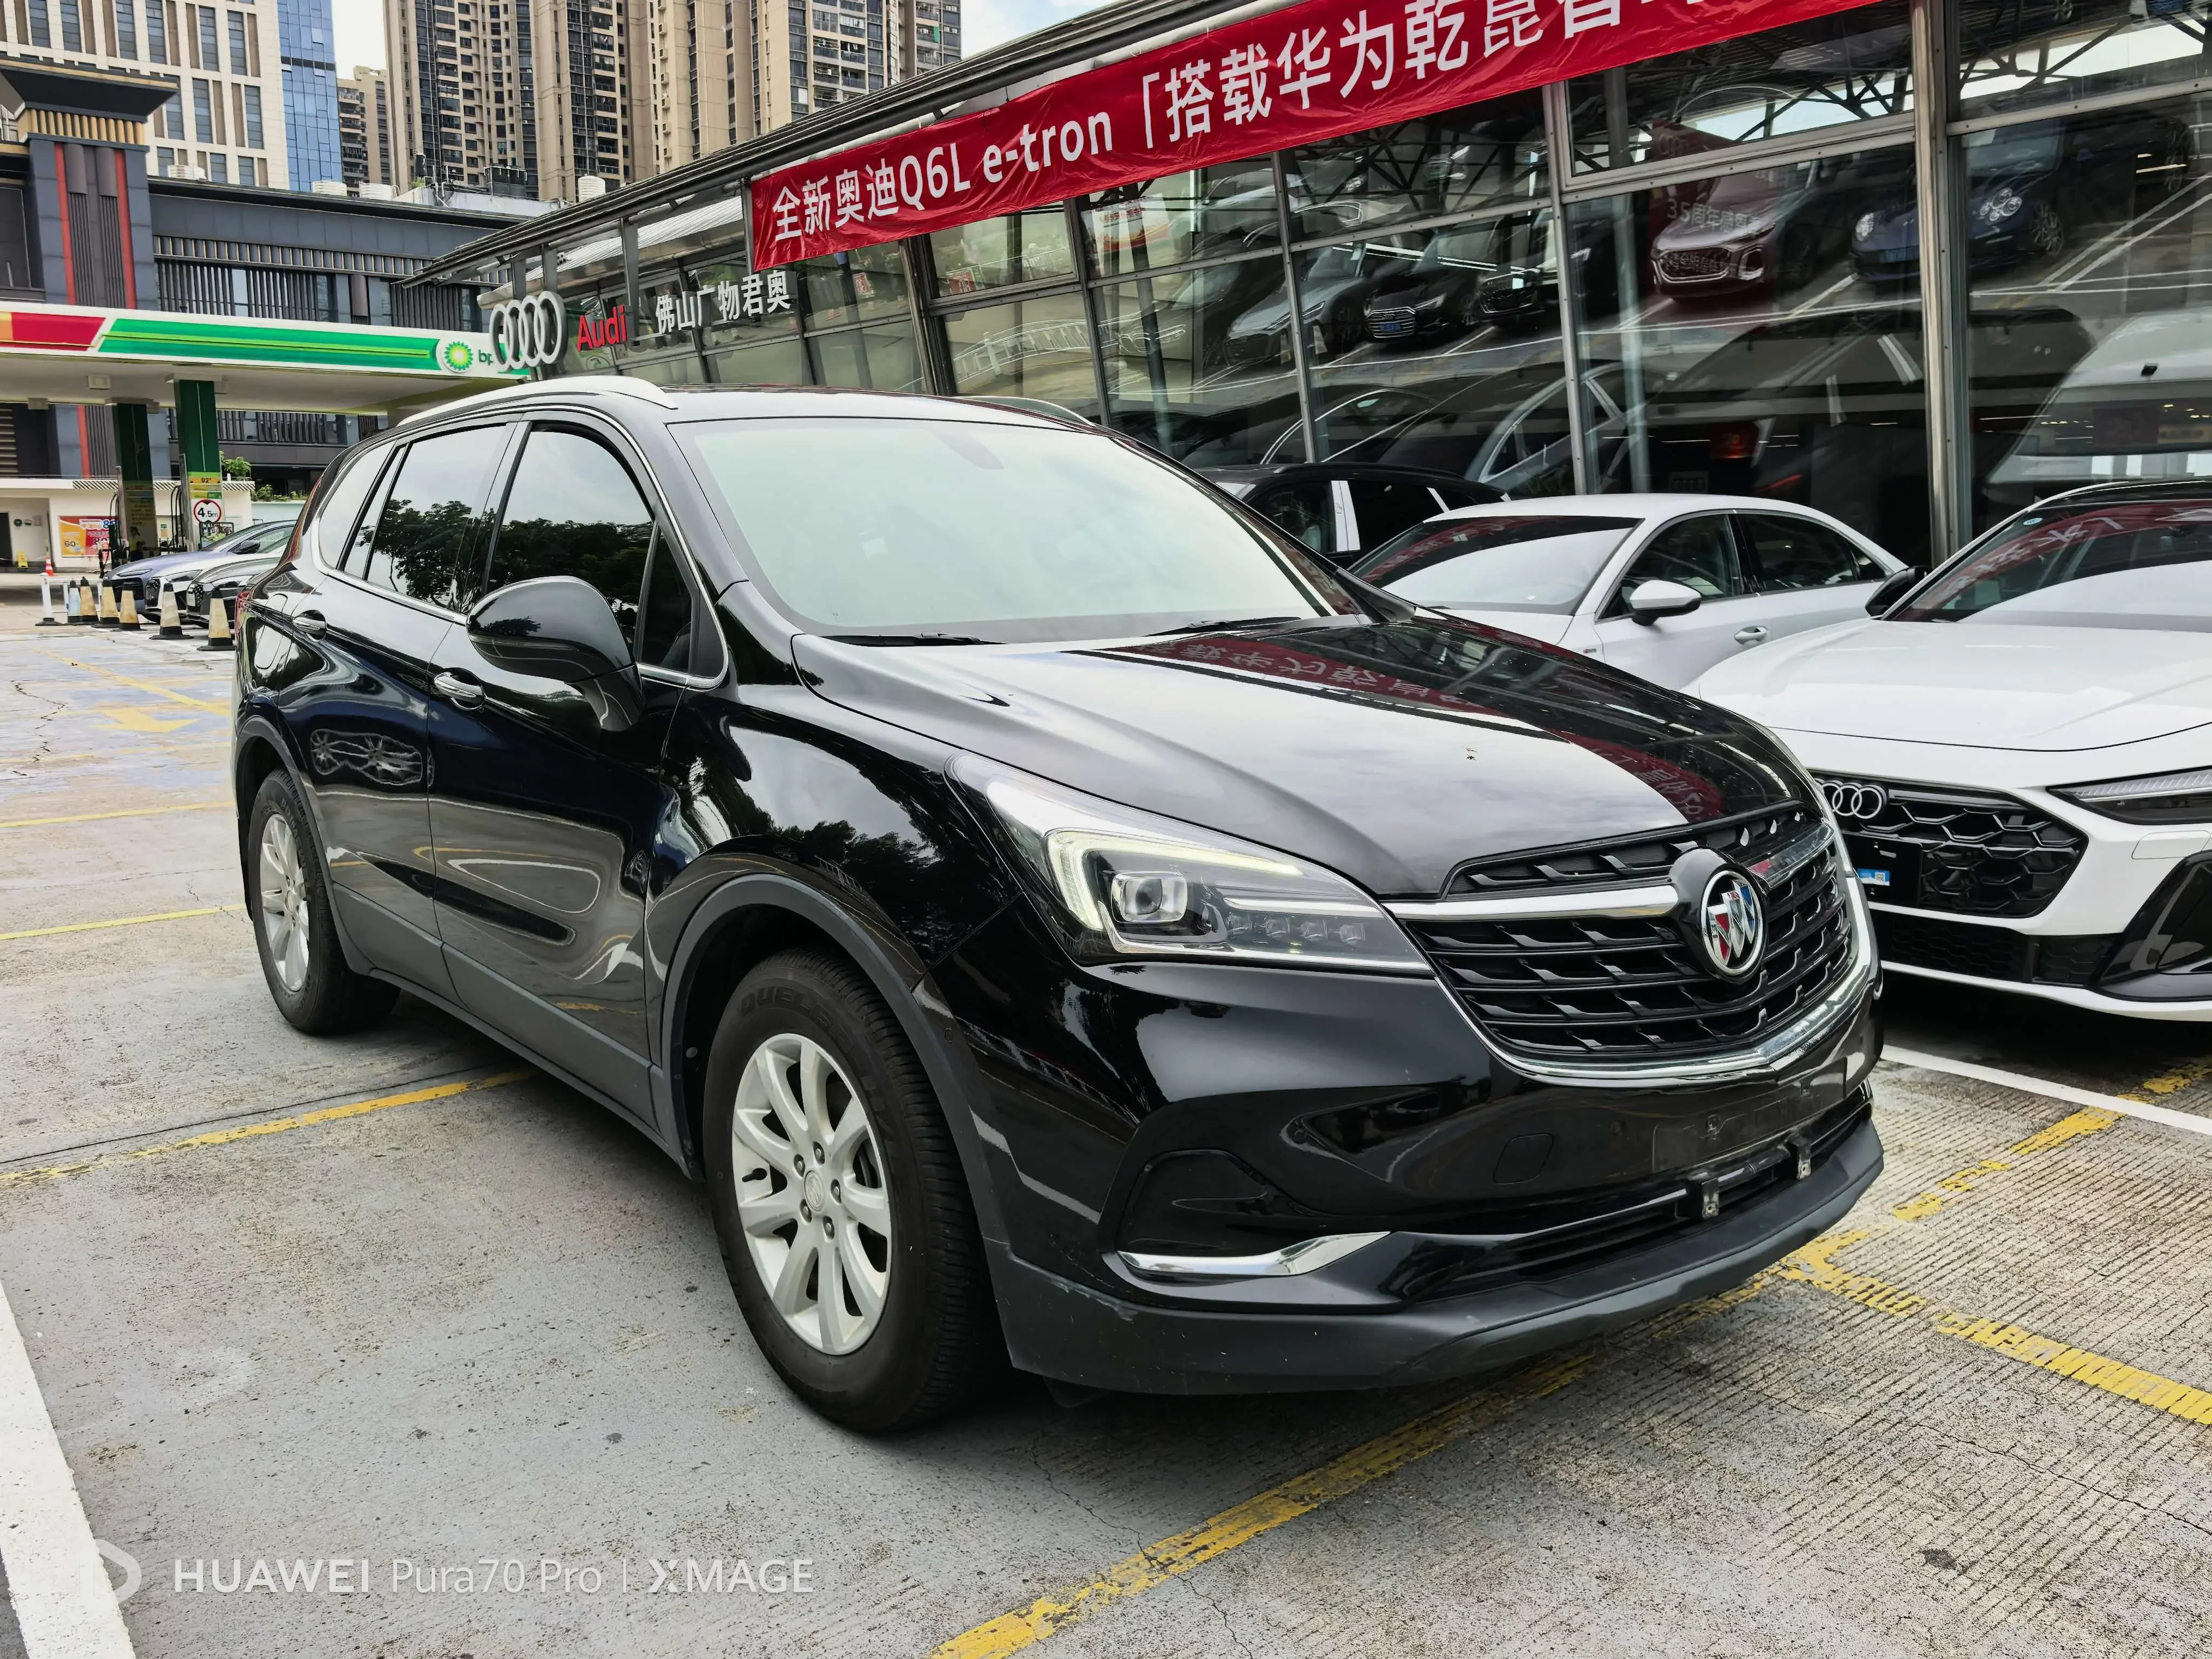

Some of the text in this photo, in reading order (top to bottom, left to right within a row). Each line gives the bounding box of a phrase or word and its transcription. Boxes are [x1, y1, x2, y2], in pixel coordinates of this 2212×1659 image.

[773, 143, 971, 242] 全新奥迪Q6L
[983, 112, 1113, 183] e-tron
[577, 305, 628, 352] Audi
[656, 269, 791, 334] 佛山广物君奥
[198, 507, 218, 517] 4.5m
